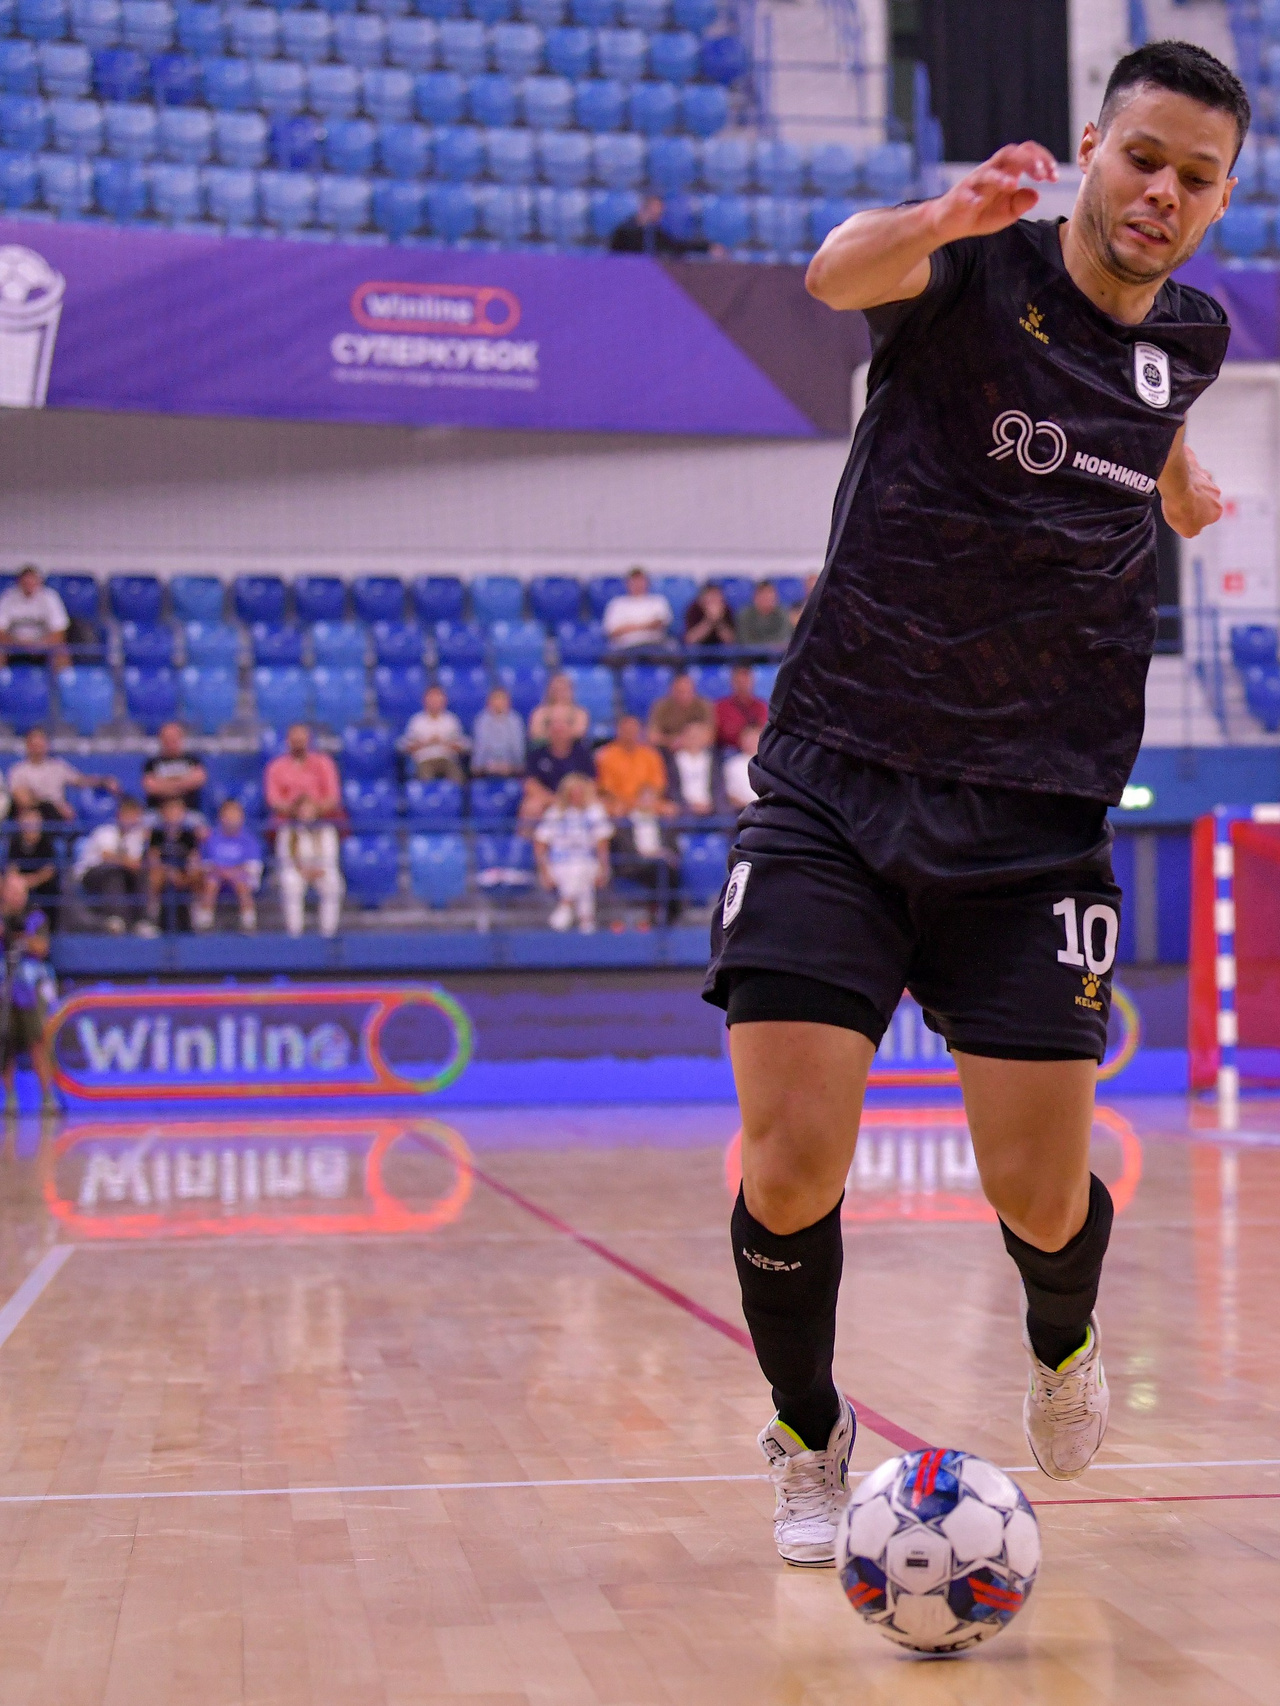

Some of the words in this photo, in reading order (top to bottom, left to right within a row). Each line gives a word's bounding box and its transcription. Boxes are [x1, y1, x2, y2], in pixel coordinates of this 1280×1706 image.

[365, 293, 475, 324] Winline
[1019, 317, 1050, 344] KELME
[330, 332, 539, 372] СУПЕРКУБОК
[1053, 897, 1119, 975] 10
[1075, 995, 1103, 1011] KELME
[78, 1014, 350, 1073] Winline
